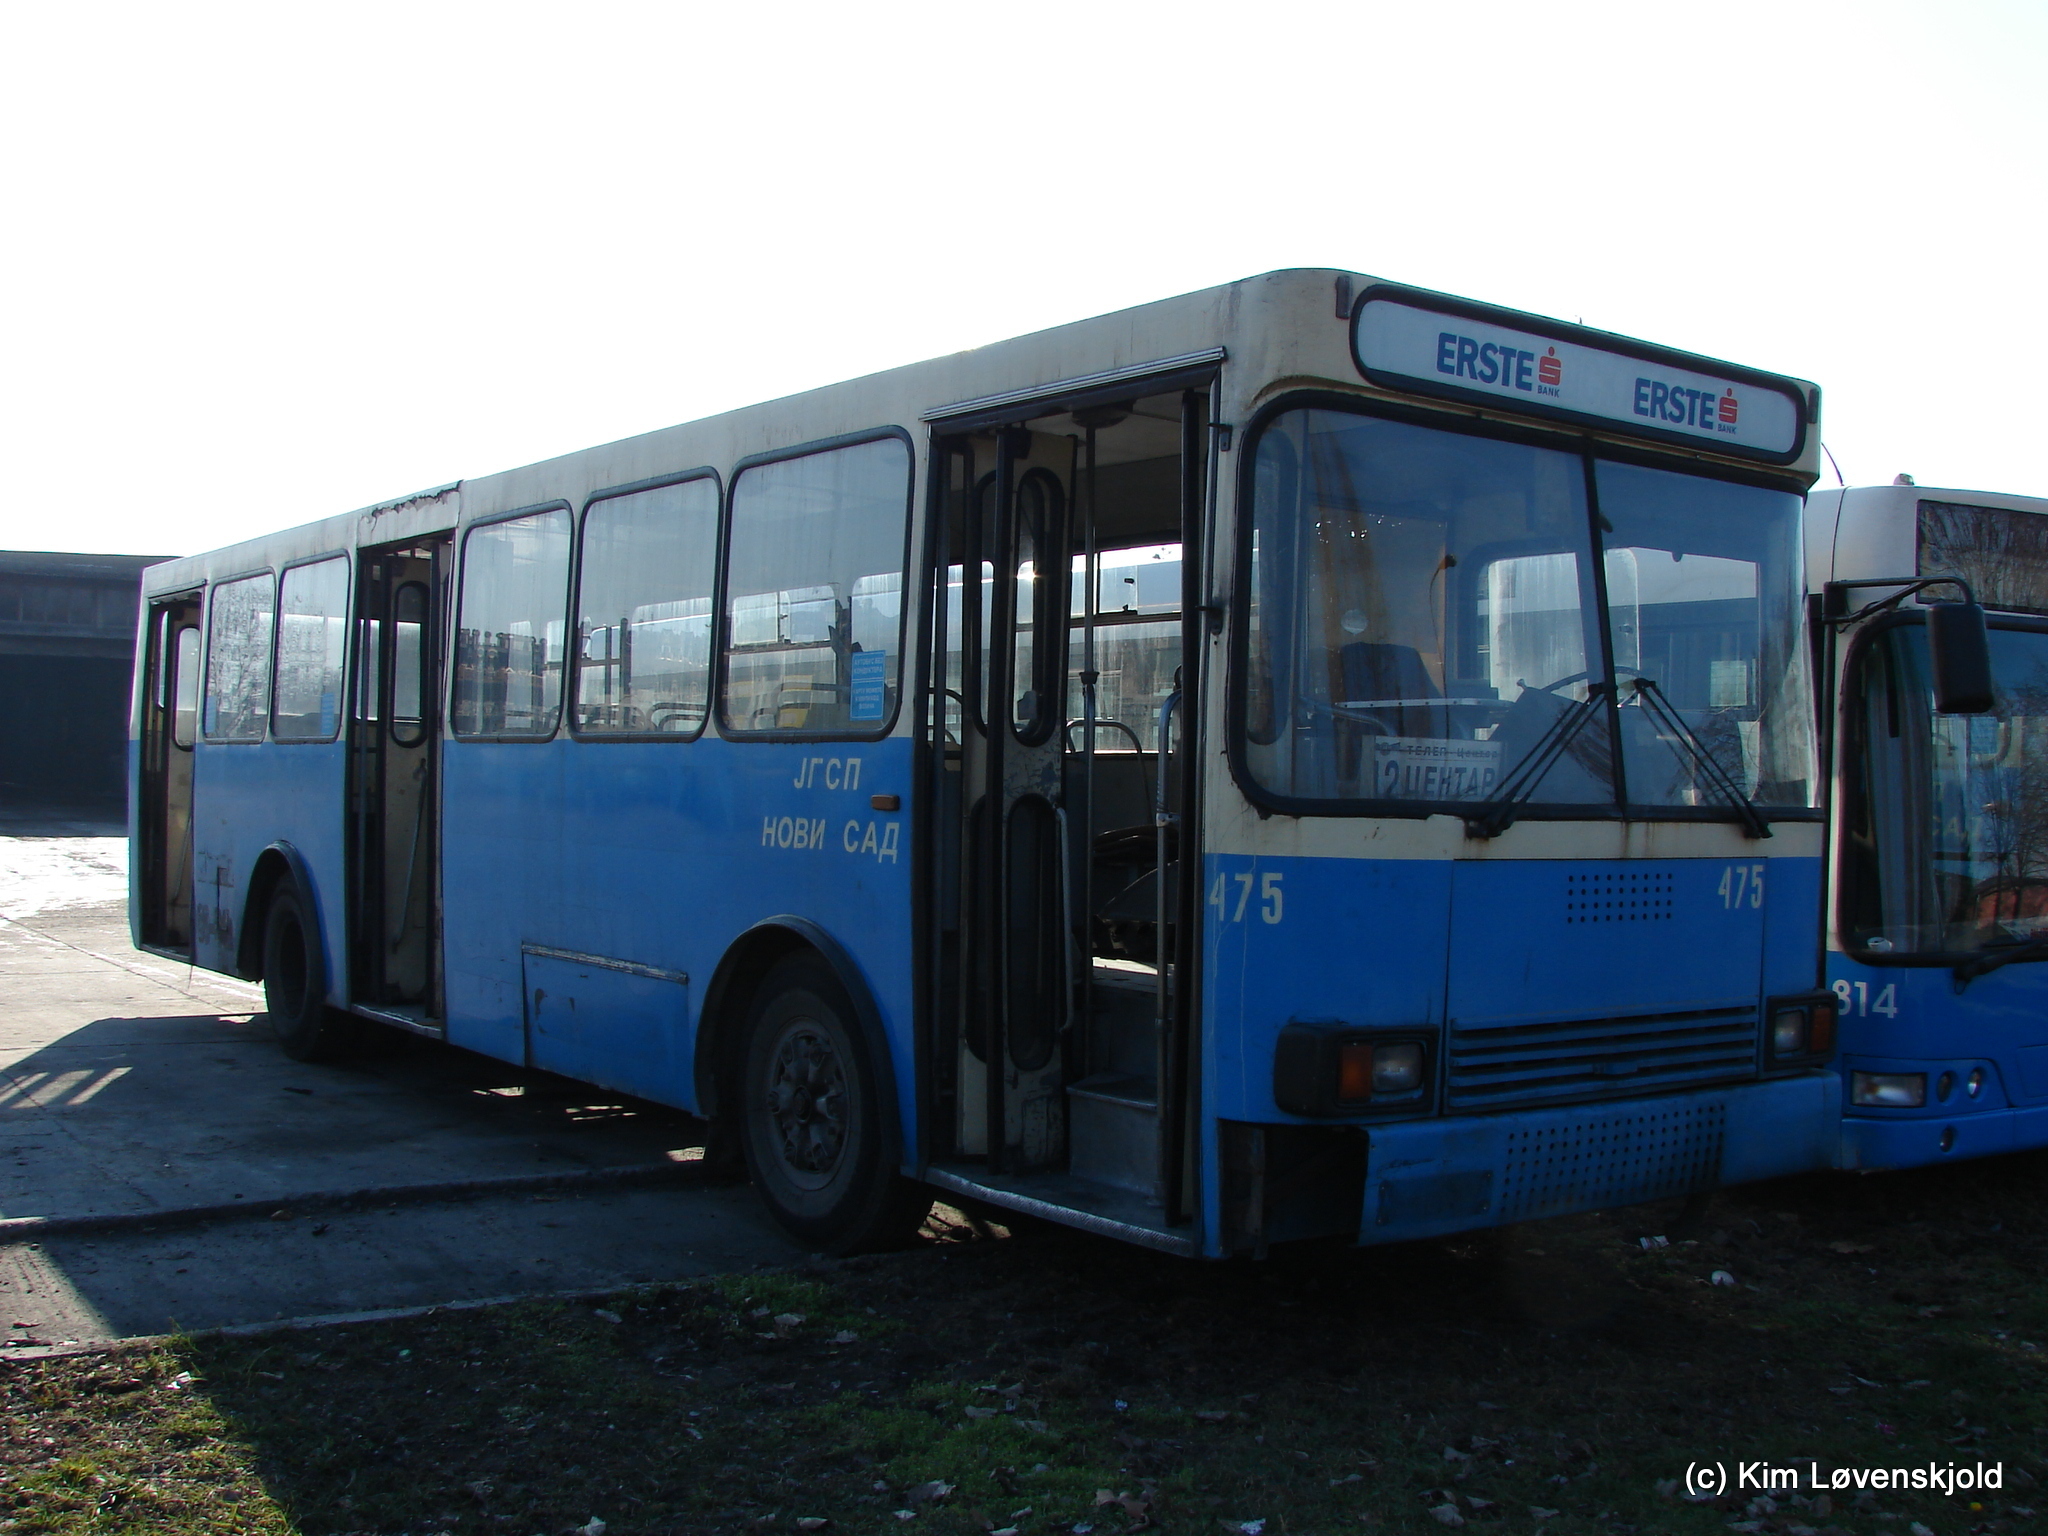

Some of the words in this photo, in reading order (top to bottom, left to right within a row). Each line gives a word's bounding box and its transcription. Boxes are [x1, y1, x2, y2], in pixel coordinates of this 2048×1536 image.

[1437, 332, 1534, 391] ERSTE
[1537, 385, 1560, 398] BANK
[1633, 377, 1715, 430] ERSTE
[1717, 423, 1737, 435] BANK
[1405, 765, 1496, 798] ЦЕНТАР
[762, 816, 826, 850] НОВИ
[843, 820, 900, 864] САД
[1209, 872, 1283, 924] 475
[1718, 865, 1764, 909] 475
[1832, 979, 1898, 1019] 814
